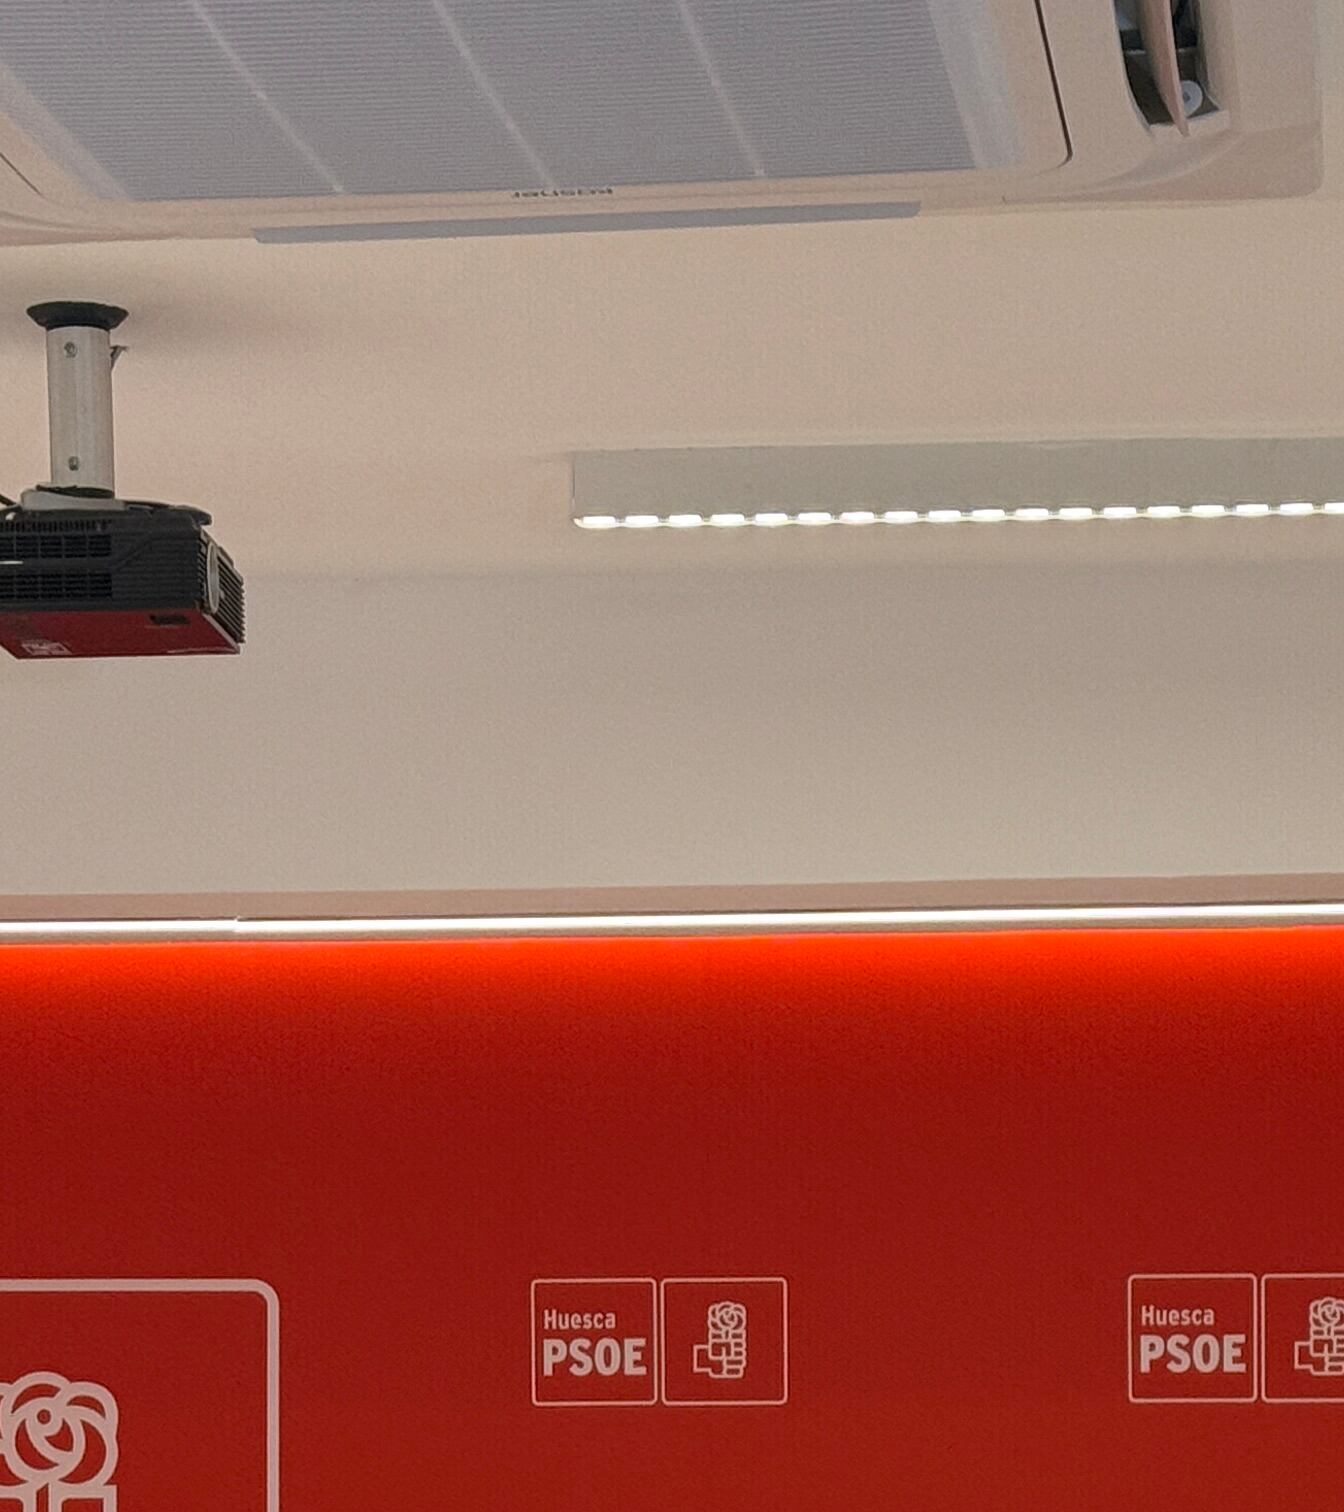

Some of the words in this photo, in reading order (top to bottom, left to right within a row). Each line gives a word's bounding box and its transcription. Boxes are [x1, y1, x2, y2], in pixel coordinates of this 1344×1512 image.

[543, 1308, 616, 1330] Huesca
[1141, 1304, 1215, 1327] Huesca
[543, 1337, 647, 1376] PSOE
[1140, 1334, 1246, 1373] PSOE
